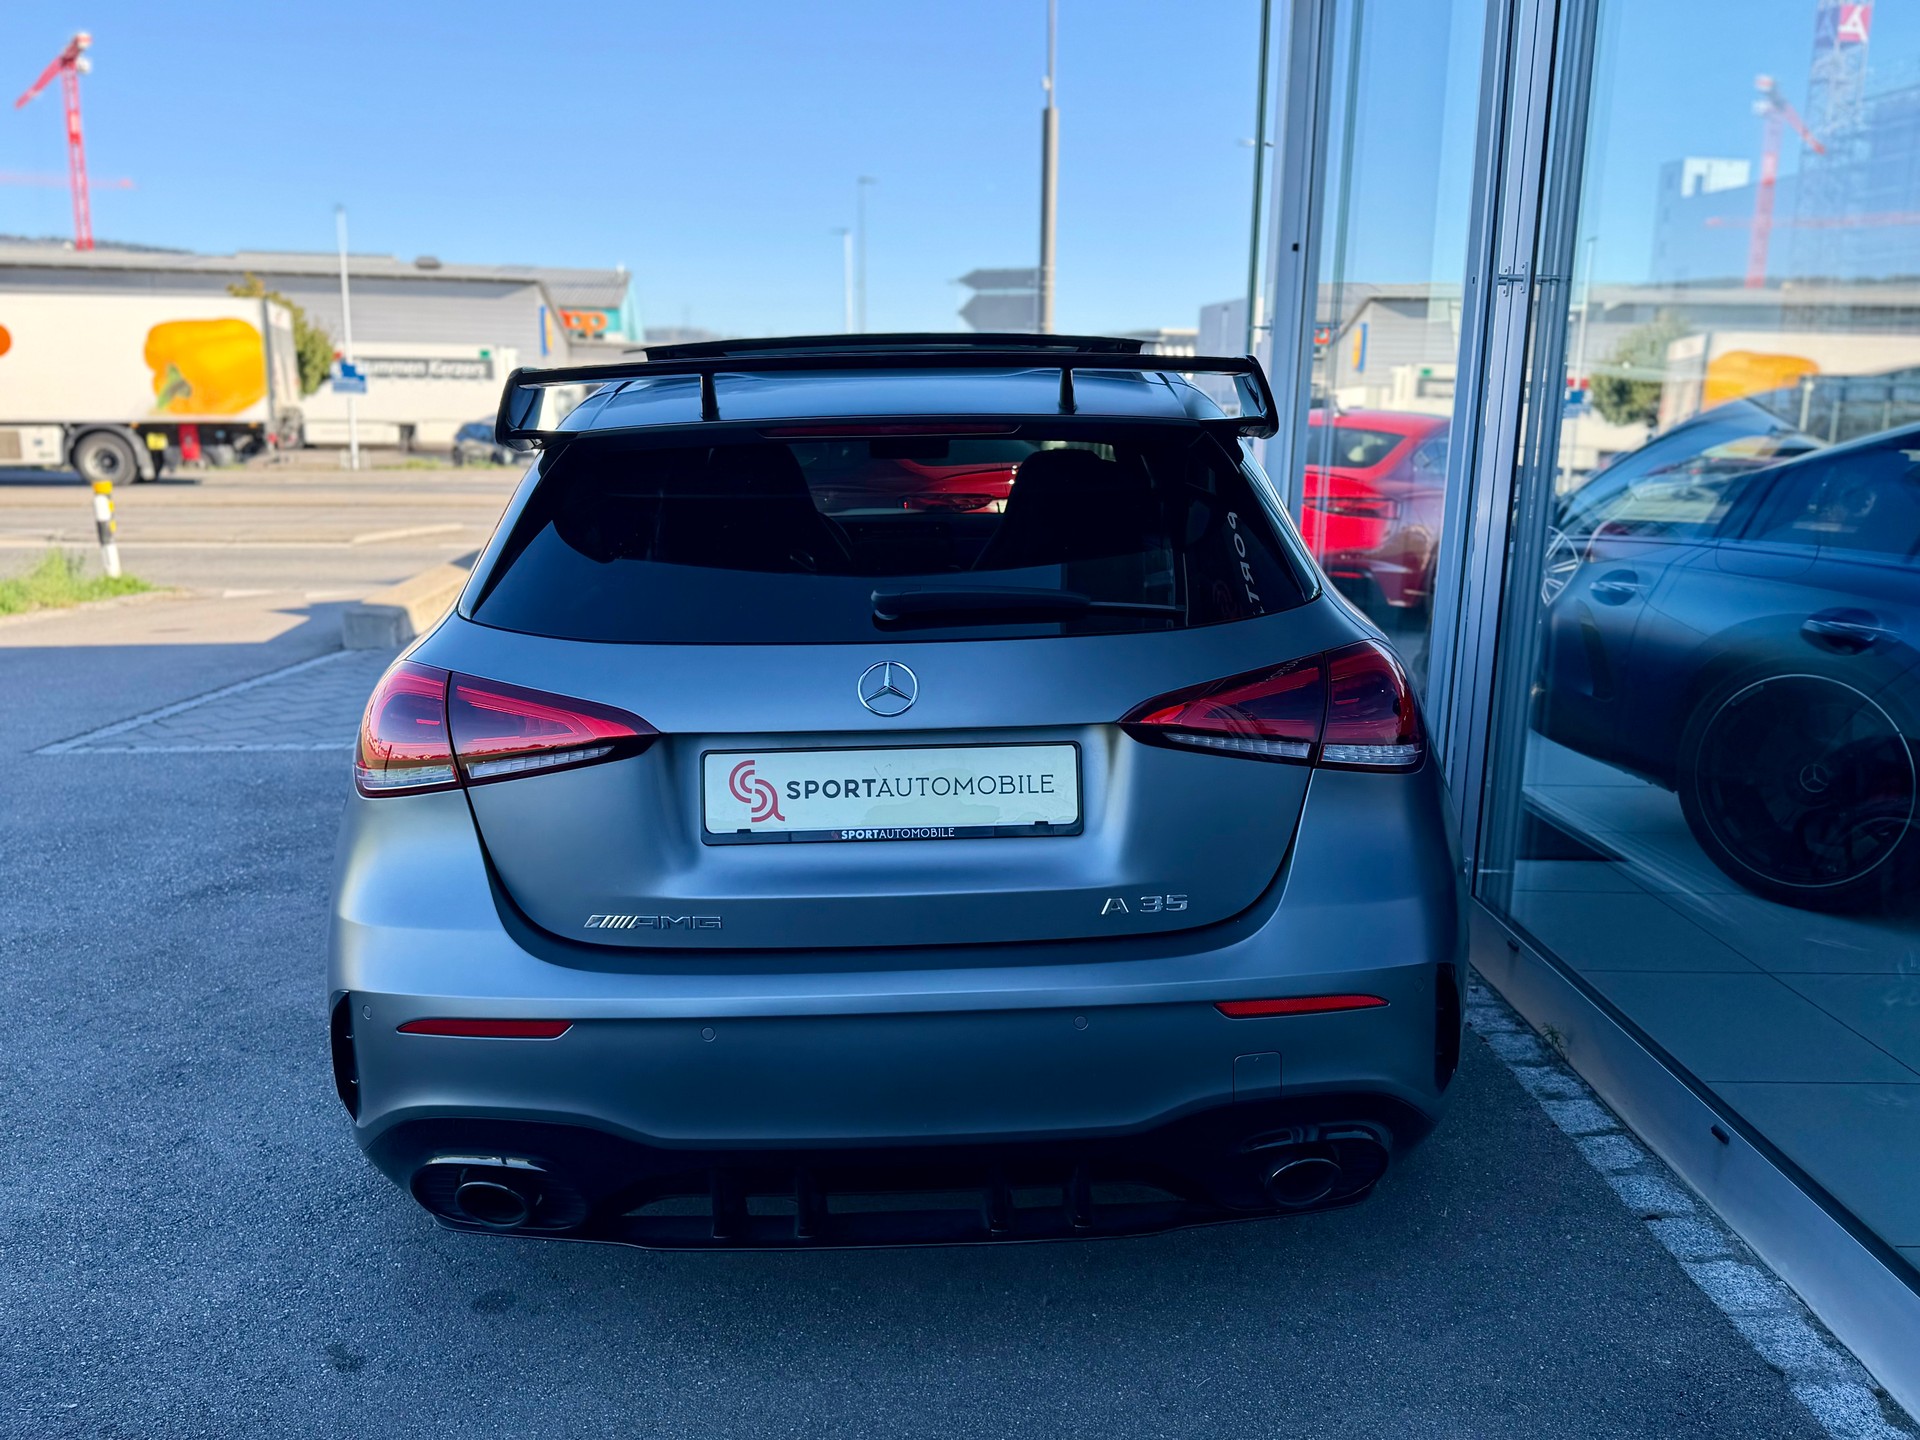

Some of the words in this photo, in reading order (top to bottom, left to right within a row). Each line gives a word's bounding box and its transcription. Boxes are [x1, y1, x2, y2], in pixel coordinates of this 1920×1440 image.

[787, 774, 1055, 799] SPORTAUTOMOBILE
[841, 828, 955, 840] SPORTAUTOMOBILE
[1101, 897, 1130, 915] A
[1140, 894, 1188, 913] 35
[634, 915, 723, 930] AMG
